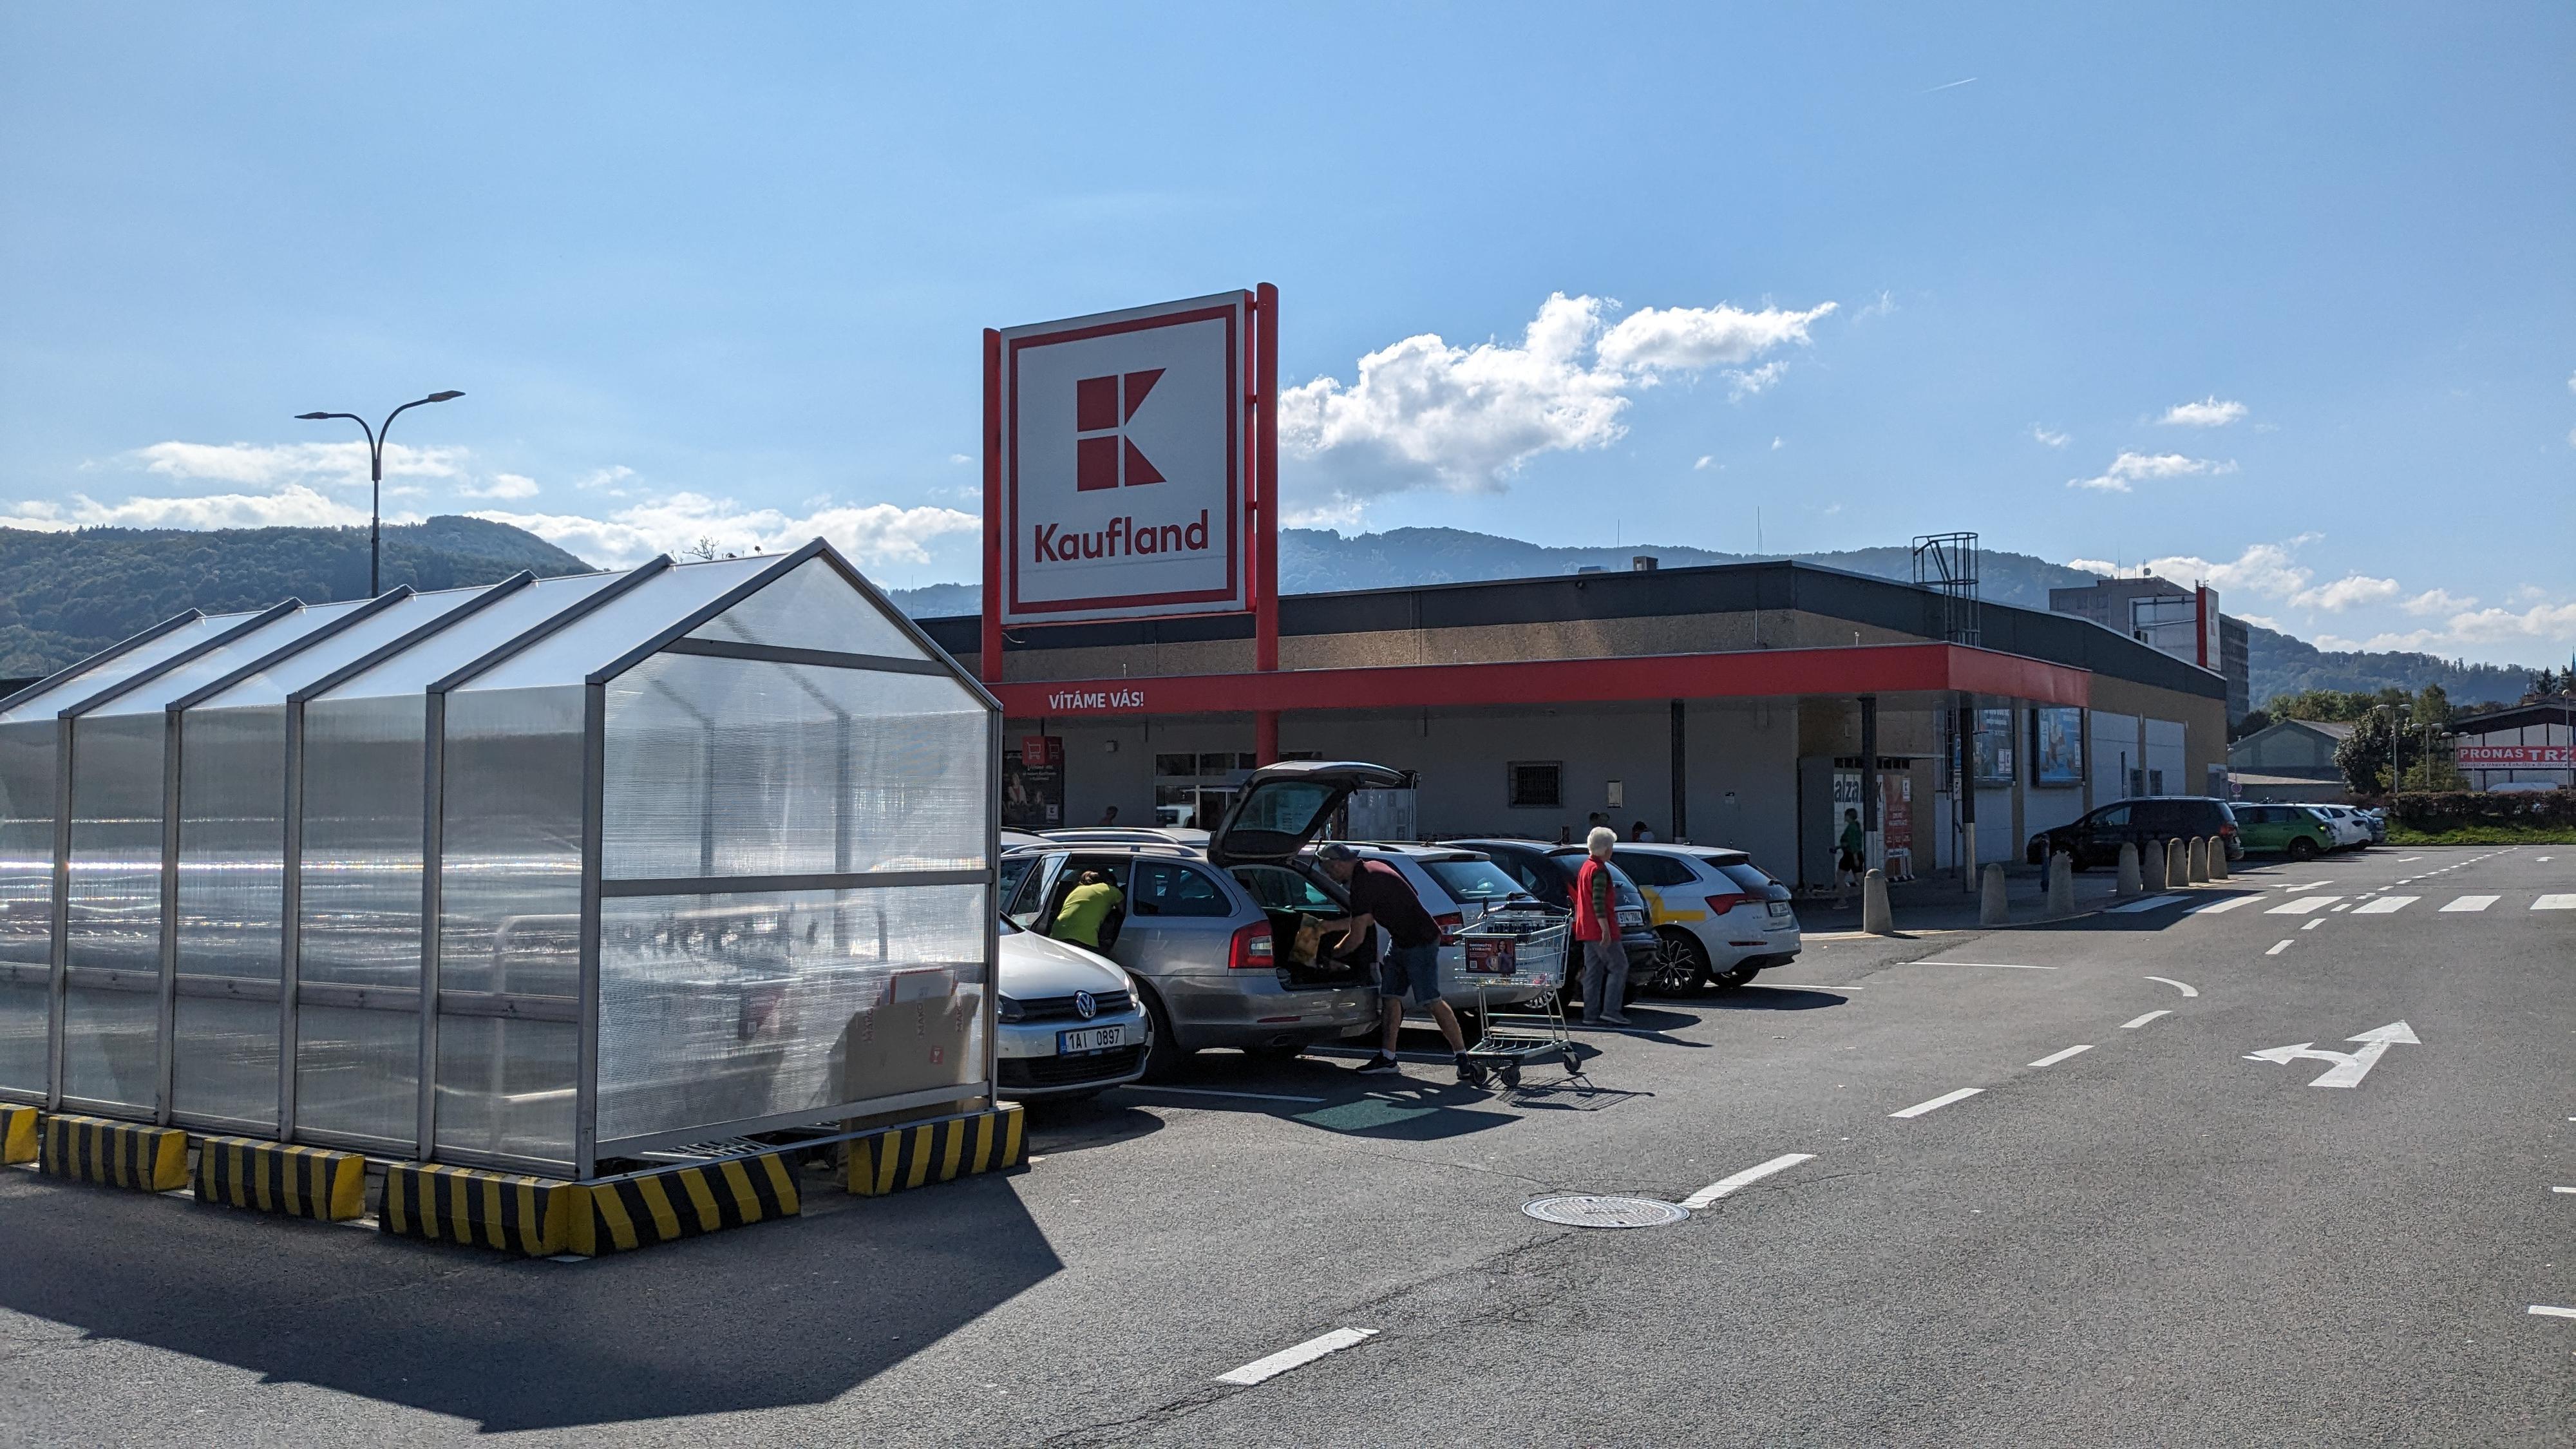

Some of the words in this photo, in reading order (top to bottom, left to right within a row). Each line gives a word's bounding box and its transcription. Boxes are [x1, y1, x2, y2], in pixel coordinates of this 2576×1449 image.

[1035, 509, 1208, 563] Kaufland
[1049, 690, 1106, 709] VÍTÁME
[1110, 688, 1144, 708] VÁS!
[2460, 748, 2524, 759] PRONAS
[1835, 780, 1882, 804] alzax
[1069, 1032, 1087, 1050] 1AI
[1097, 1028, 1120, 1046] 0897
